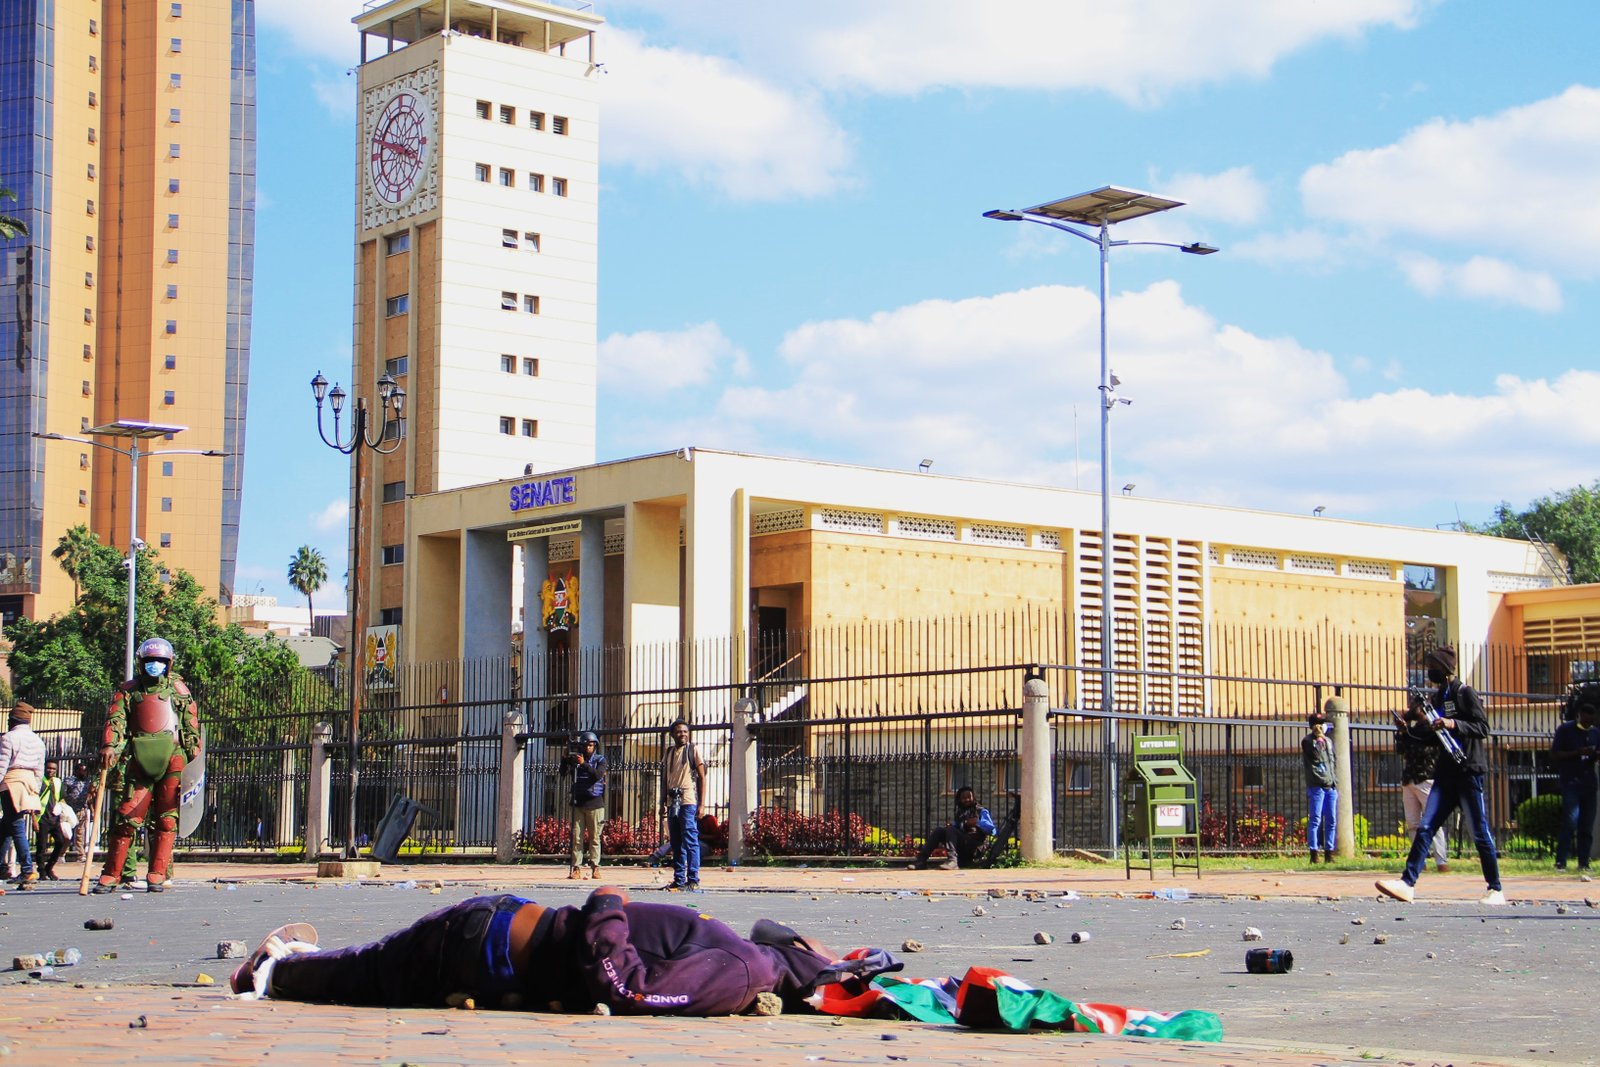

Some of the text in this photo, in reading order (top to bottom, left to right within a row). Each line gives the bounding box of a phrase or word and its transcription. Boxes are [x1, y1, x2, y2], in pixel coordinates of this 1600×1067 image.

[510, 476, 575, 511] SENATE
[1140, 740, 1177, 749] LITTER BIN
